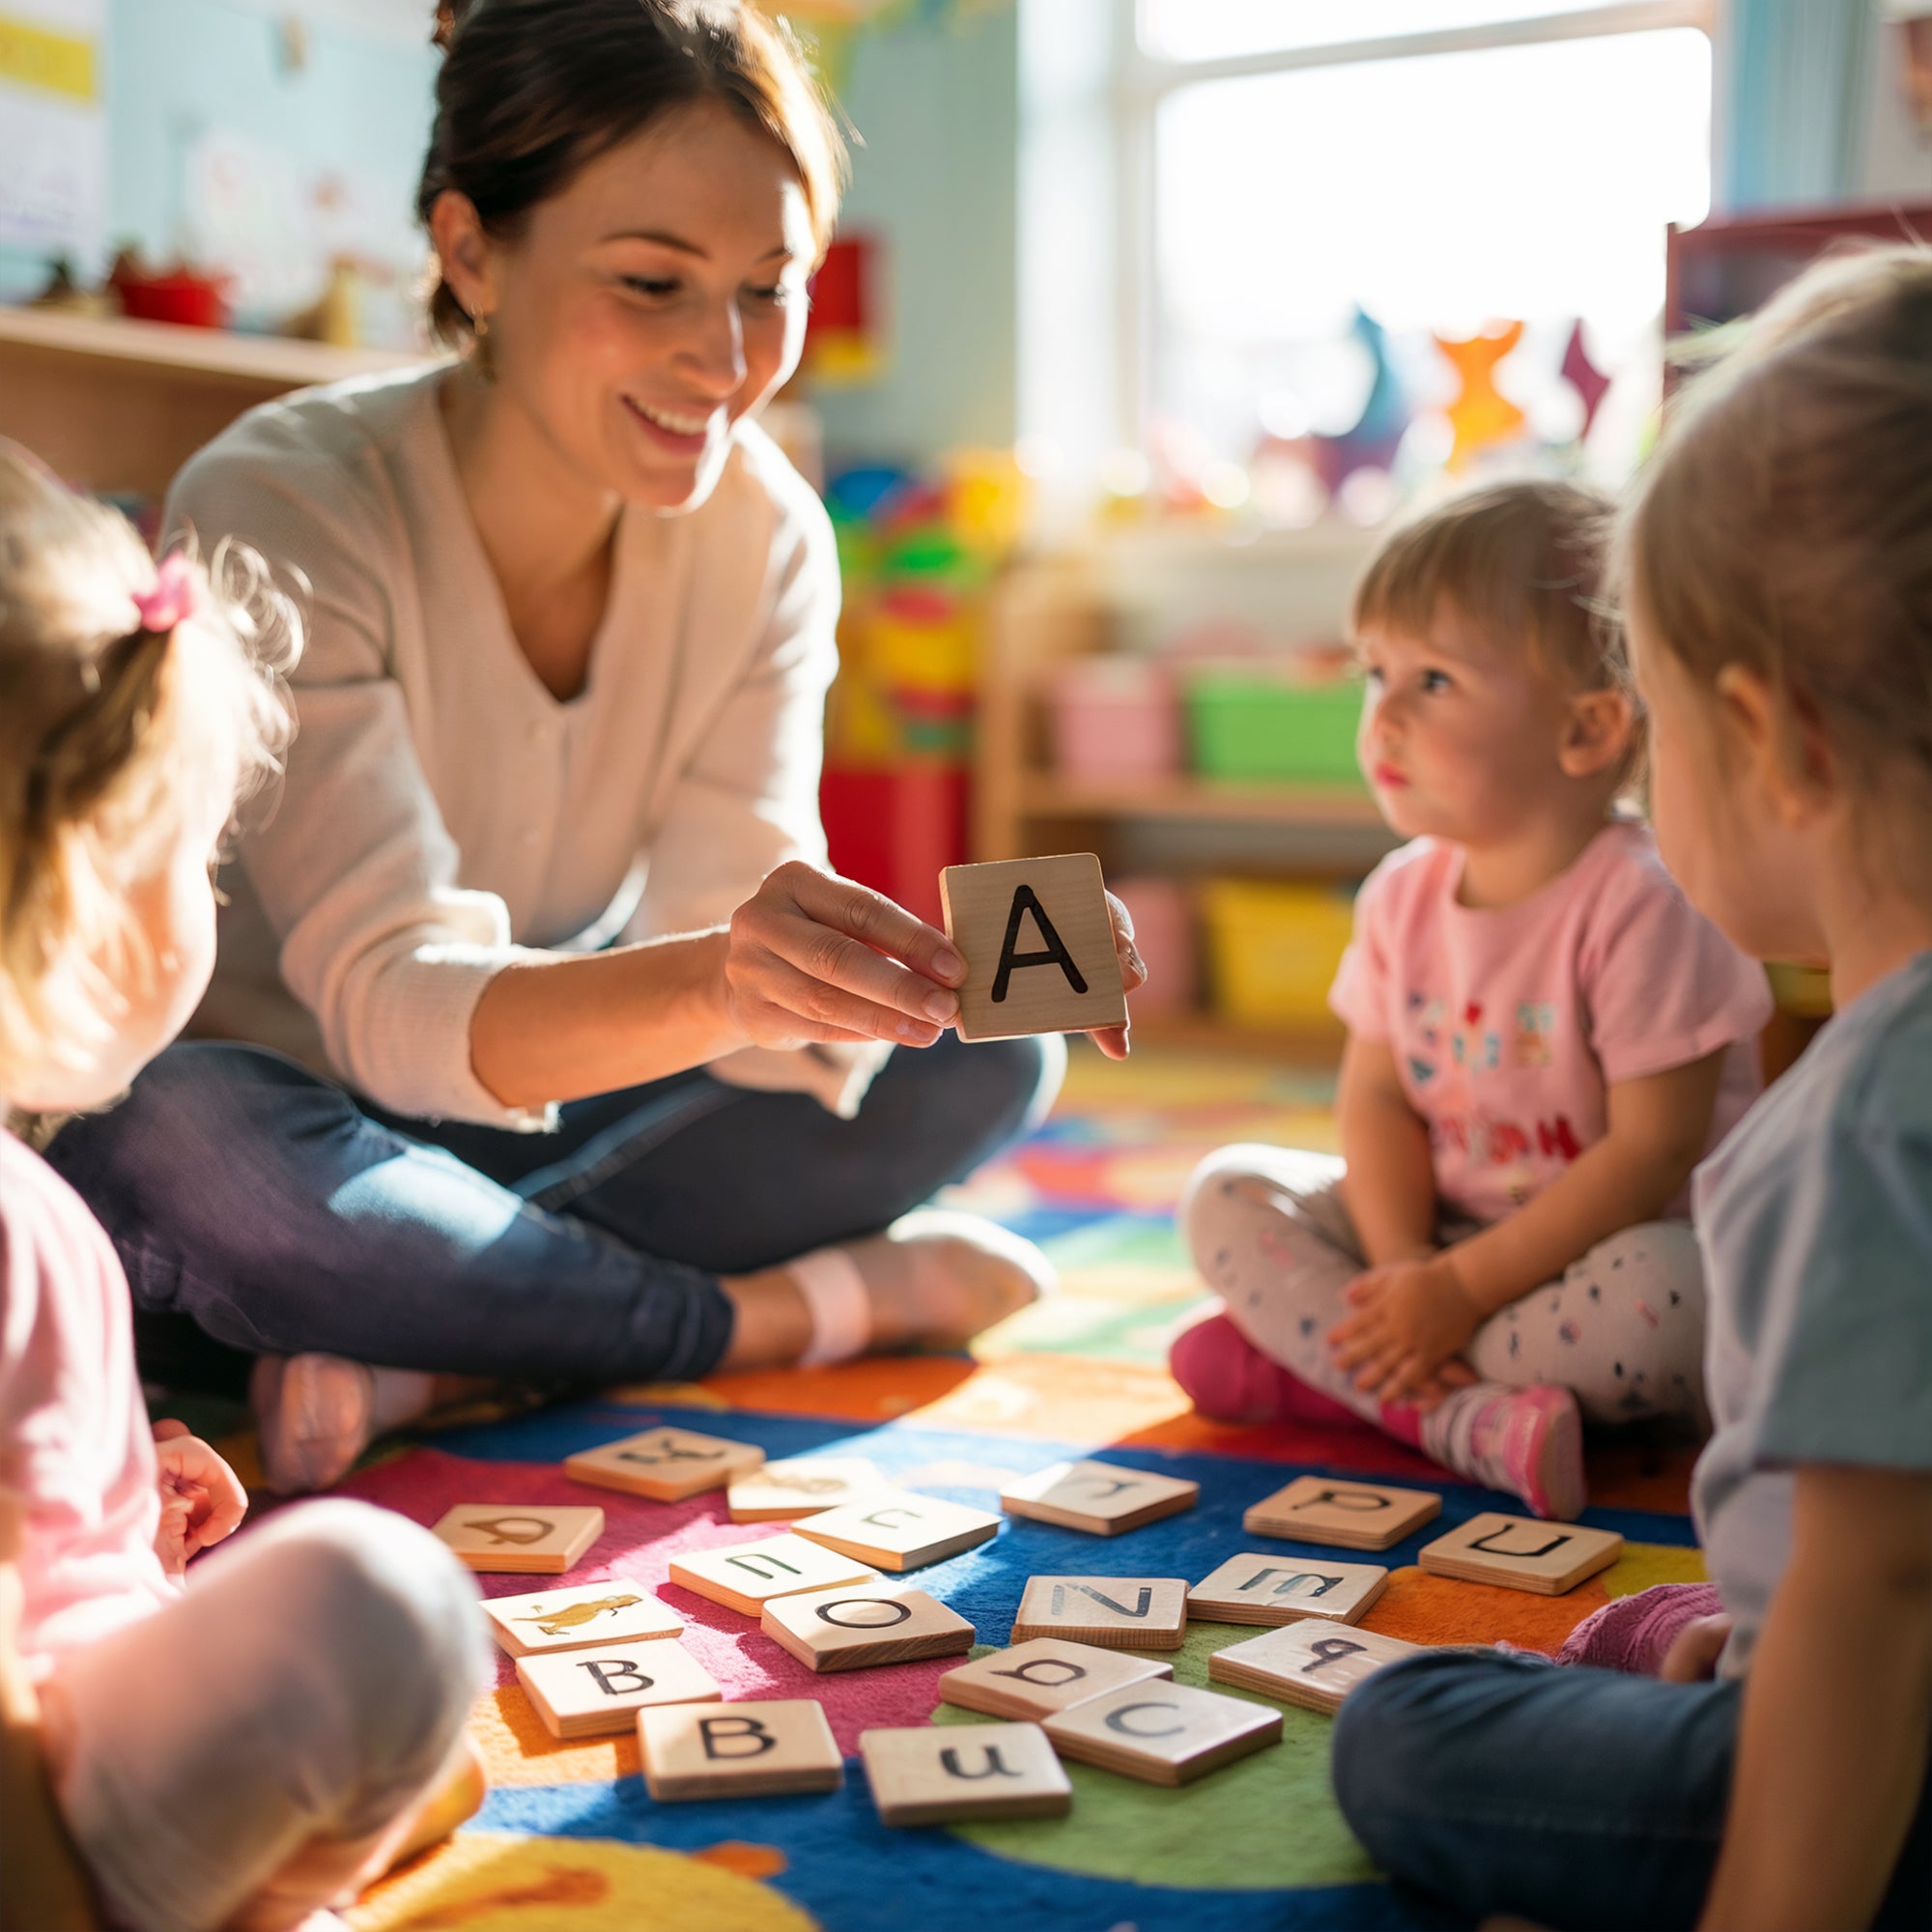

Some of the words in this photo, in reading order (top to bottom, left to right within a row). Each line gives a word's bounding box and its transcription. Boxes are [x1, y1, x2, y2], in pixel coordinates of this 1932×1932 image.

[991, 884, 1089, 1004] A
[575, 1659, 655, 1696] B
[696, 1716, 779, 1761] B
